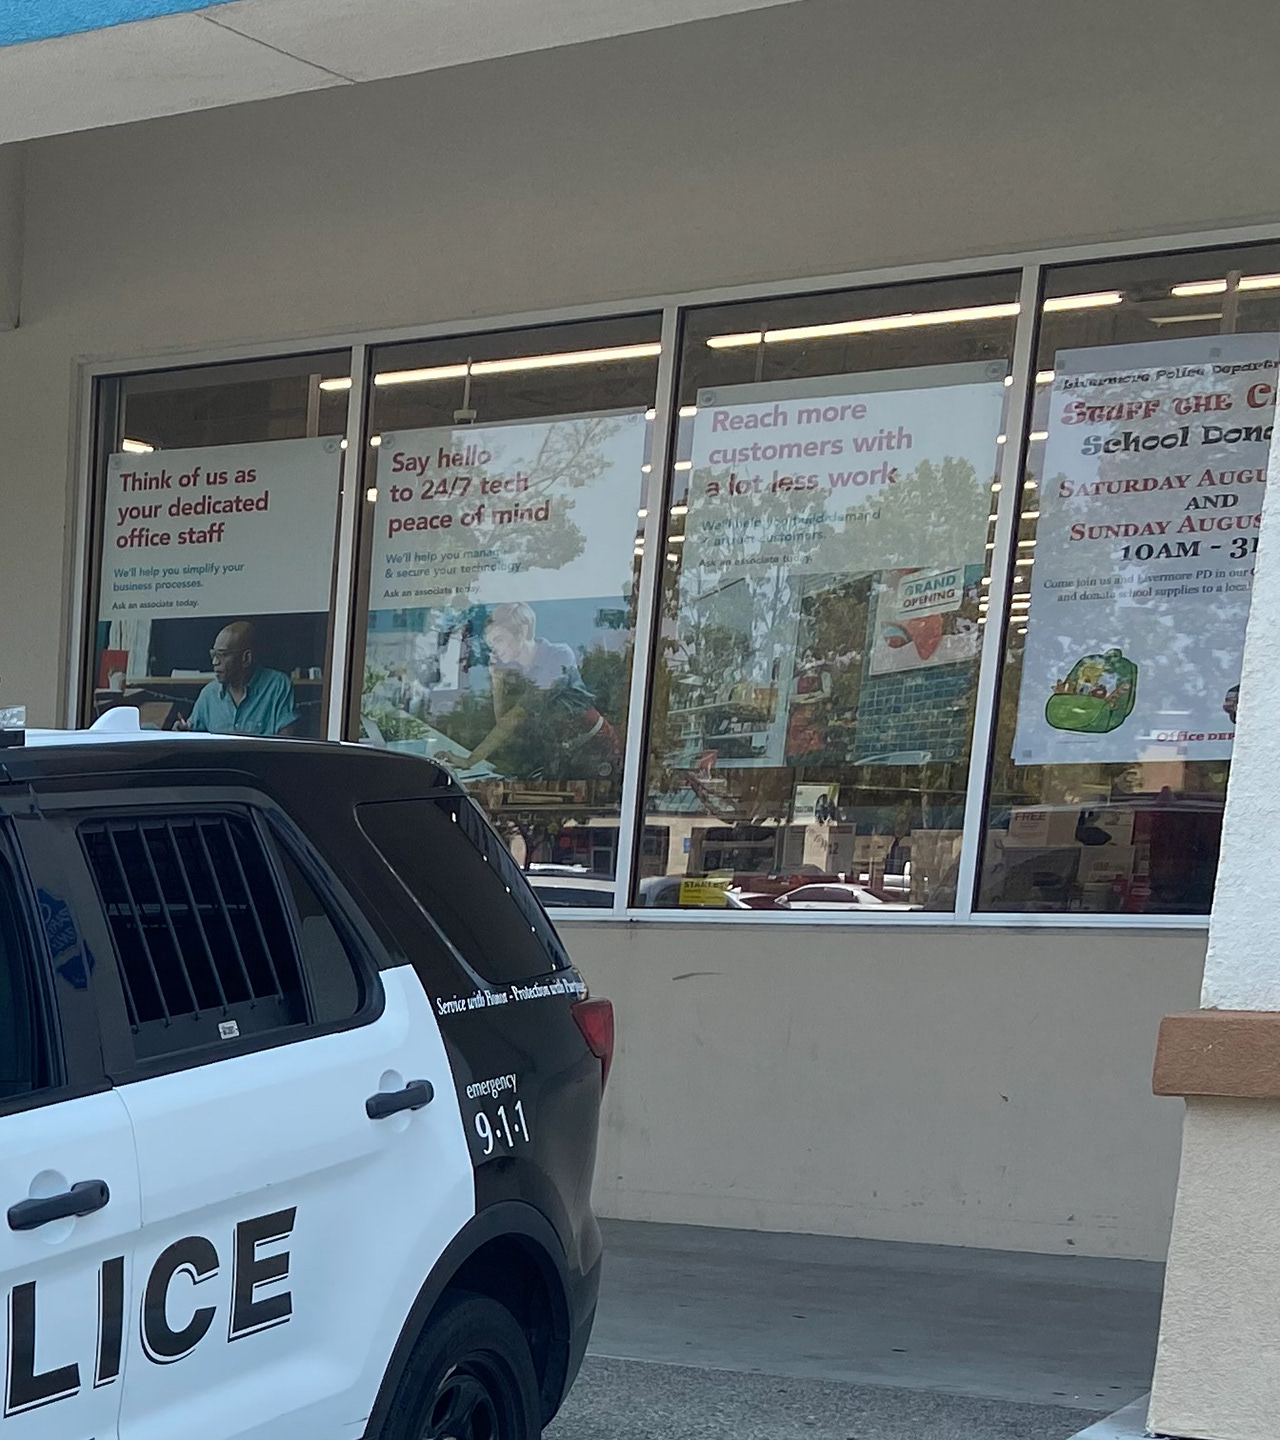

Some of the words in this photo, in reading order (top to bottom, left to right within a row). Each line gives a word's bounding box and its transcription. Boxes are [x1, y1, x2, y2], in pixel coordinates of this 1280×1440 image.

[1155, 366, 1206, 381] Police
[712, 404, 787, 432] Reach
[797, 402, 867, 424] more
[709, 438, 843, 464] customers
[852, 426, 913, 451] with
[1080, 426, 1190, 455] School
[392, 452, 431, 476] Say
[438, 444, 492, 468] hello
[120, 469, 172, 492] Think
[178, 466, 201, 487] of
[206, 470, 228, 485] us
[234, 468, 257, 483] as
[390, 484, 413, 502] to
[421, 476, 472, 500] 24/7
[480, 472, 529, 494] tech
[705, 480, 720, 497] a
[728, 473, 763, 496] lot
[772, 467, 819, 492] less
[828, 461, 898, 488] work
[1058, 474, 1191, 498] SATURDAY
[117, 503, 162, 526] your
[168, 490, 269, 517] dedicated
[1184, 494, 1239, 511] AND
[388, 513, 453, 538] peace
[460, 504, 485, 526] of
[492, 500, 550, 525] mind
[117, 528, 171, 548] office
[178, 522, 225, 545] staff
[1069, 520, 1172, 541] SUNDAY
[385, 552, 411, 564] We'll
[414, 551, 437, 564] help
[440, 552, 459, 563] you
[1119, 540, 1202, 561] 10AM
[114, 567, 137, 578] We'll
[139, 567, 160, 579] help
[162, 568, 180, 578] you
[183, 563, 221, 576] simplify
[222, 563, 245, 574] your
[385, 569, 393, 578] &
[396, 568, 430, 578] secure
[433, 566, 457, 578] your
[1043, 578, 1074, 589] Come
[1076, 577, 1097, 589] join
[1099, 576, 1113, 586] us
[1195, 569, 1213, 580] PD
[1215, 568, 1226, 579] in
[1229, 568, 1250, 578] our
[113, 581, 152, 592] business
[155, 580, 204, 592] processes.
[383, 589, 399, 598] Ask
[402, 589, 412, 597] an
[414, 586, 452, 596] associate
[904, 575, 956, 596] GRAND
[1057, 591, 1077, 602] and
[1155, 583, 1199, 598] supplies
[1202, 582, 1214, 594] to
[1215, 584, 1223, 593] a
[112, 601, 126, 610] Ask
[140, 600, 173, 609] associate
[176, 599, 199, 608] today.
[903, 588, 955, 608] OPENING
[1157, 730, 1205, 742] Office
[437, 995, 467, 1015] Service
[467, 990, 486, 1010] with
[511, 981, 550, 1001] Protection
[466, 1073, 517, 1099] emergency
